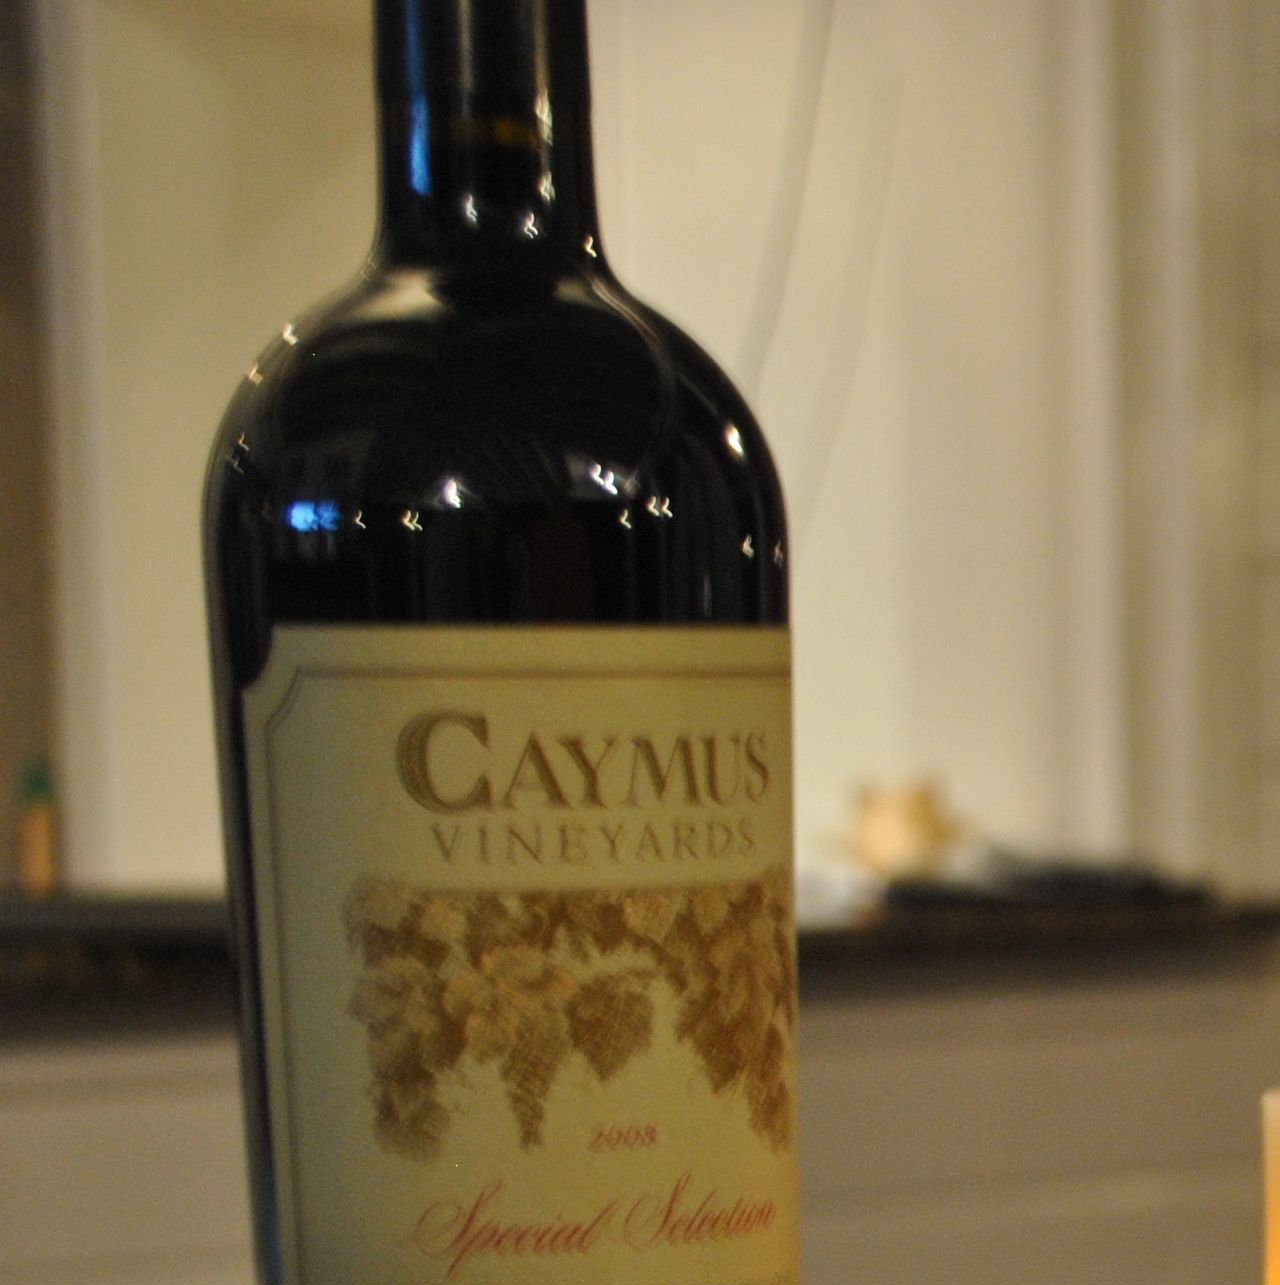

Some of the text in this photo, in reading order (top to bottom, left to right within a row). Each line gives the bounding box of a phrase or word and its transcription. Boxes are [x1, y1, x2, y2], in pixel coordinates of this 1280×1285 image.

[395, 708, 771, 814] CAYMUS
[432, 817, 756, 866] VINEYARDS
[588, 1122, 659, 1154] 2008
[412, 1170, 777, 1280] Special Selection
